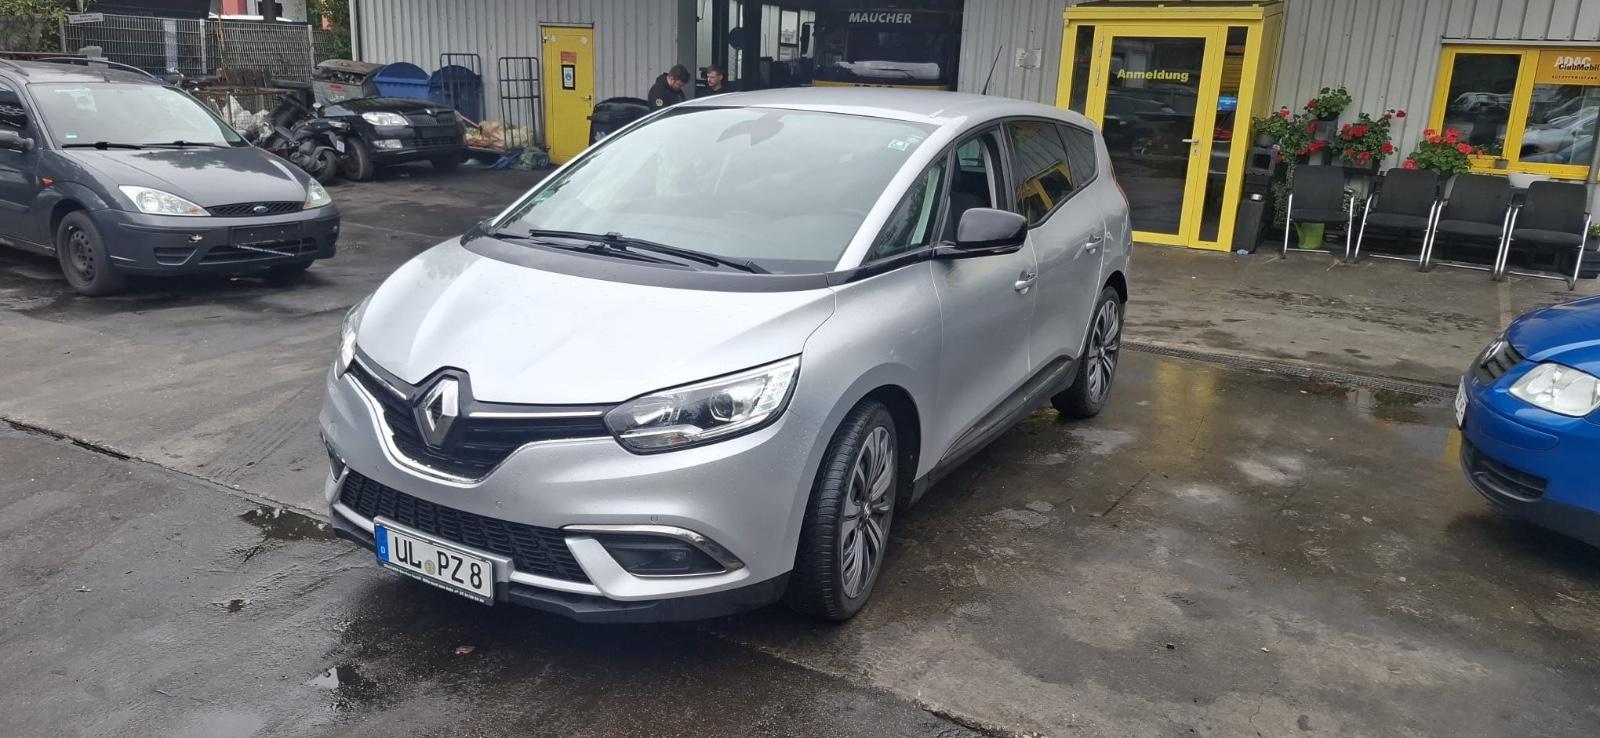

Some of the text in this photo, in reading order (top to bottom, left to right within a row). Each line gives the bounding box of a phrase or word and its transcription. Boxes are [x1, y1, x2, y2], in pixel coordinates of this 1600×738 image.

[848, 12, 912, 24] MAUCHER
[1553, 56, 1591, 68] ADAC
[1558, 63, 1600, 71] ClubMobil
[1117, 69, 1189, 82] Anmeldung
[395, 537, 421, 569] UL
[437, 551, 464, 584] PZ
[470, 562, 482, 589] 8
